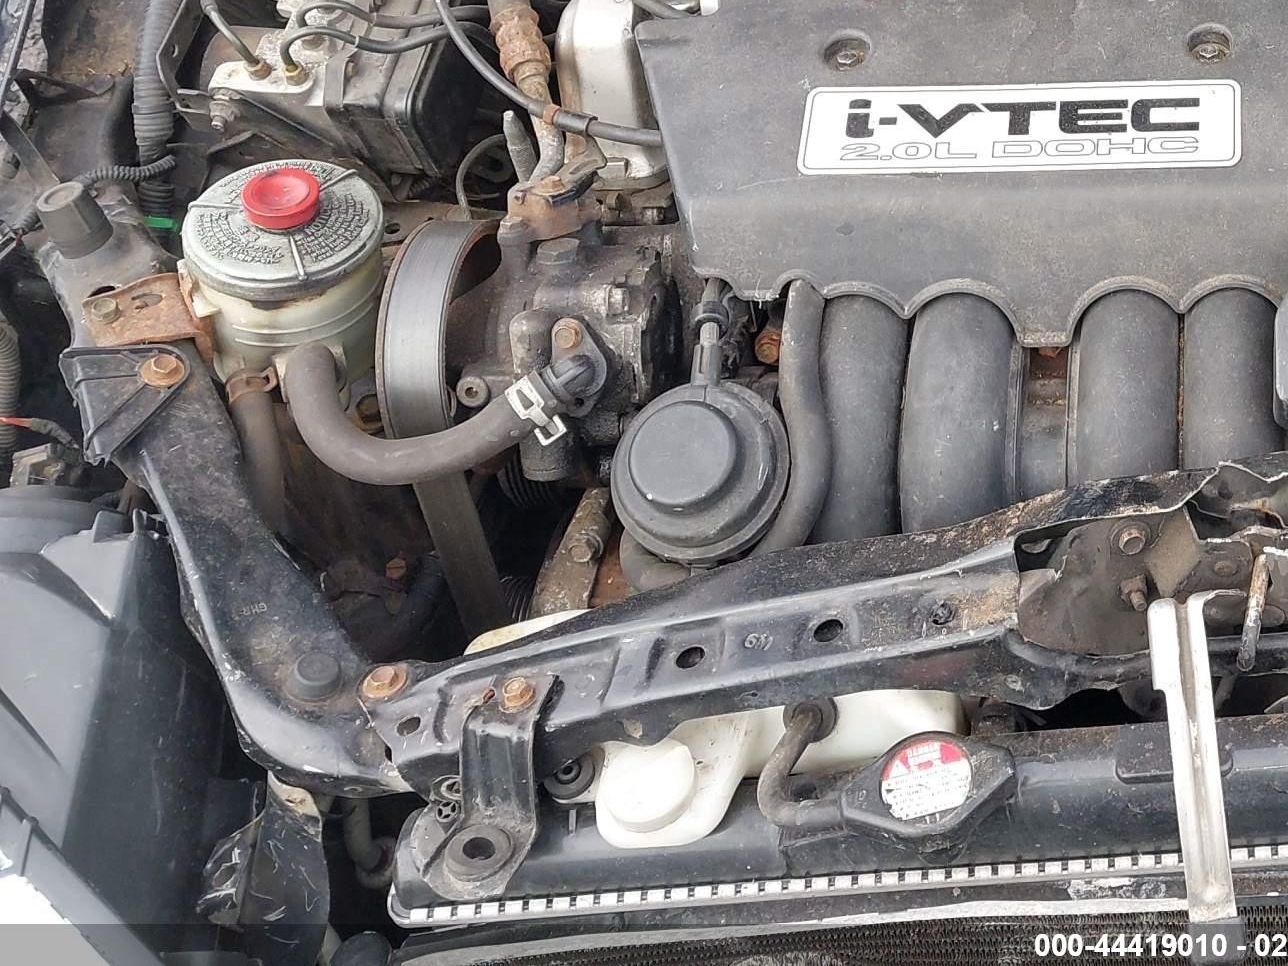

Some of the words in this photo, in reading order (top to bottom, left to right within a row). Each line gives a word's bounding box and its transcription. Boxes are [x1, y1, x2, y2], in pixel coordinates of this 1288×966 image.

[845, 98, 1200, 139] i-VTEC
[840, 141, 977, 161] 2.0L
[991, 136, 1199, 159] DOHC
